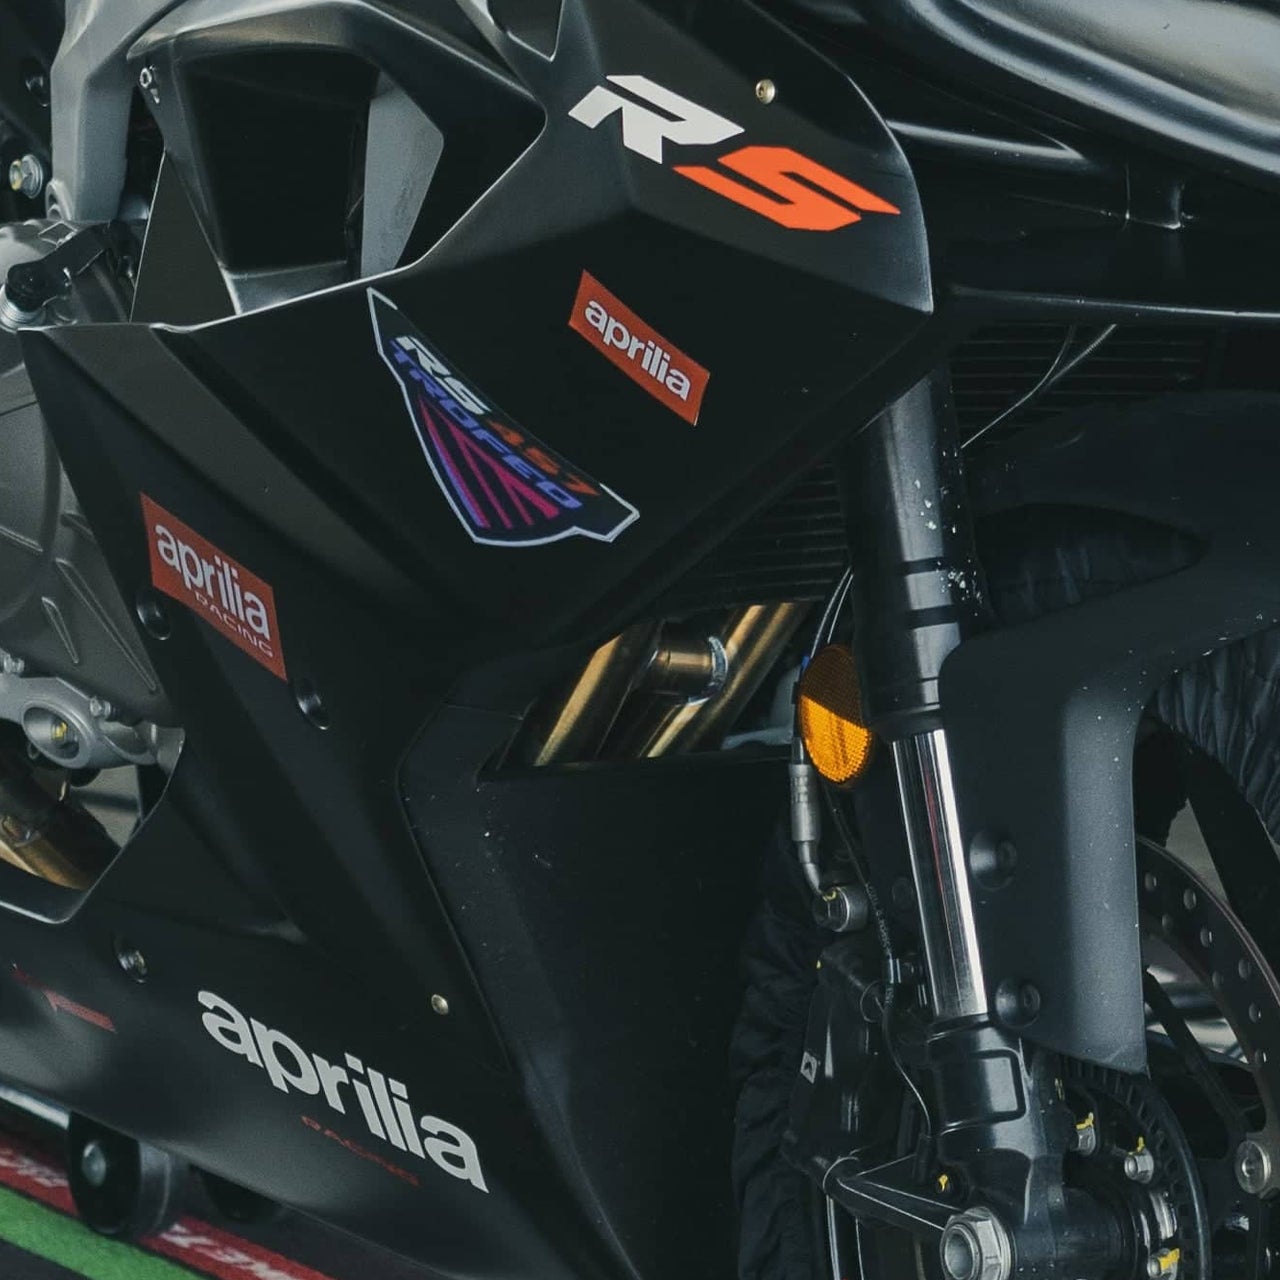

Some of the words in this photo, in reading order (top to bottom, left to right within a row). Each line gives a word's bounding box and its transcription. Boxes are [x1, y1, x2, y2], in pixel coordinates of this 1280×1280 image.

[568, 75, 901, 231] RS
[396, 335, 492, 415] RS
[584, 300, 690, 401] aprilia
[389, 338, 583, 509] TROFEO
[155, 524, 271, 641] aprilia
[195, 590, 273, 658] RACING
[198, 990, 490, 1194] aprilia
